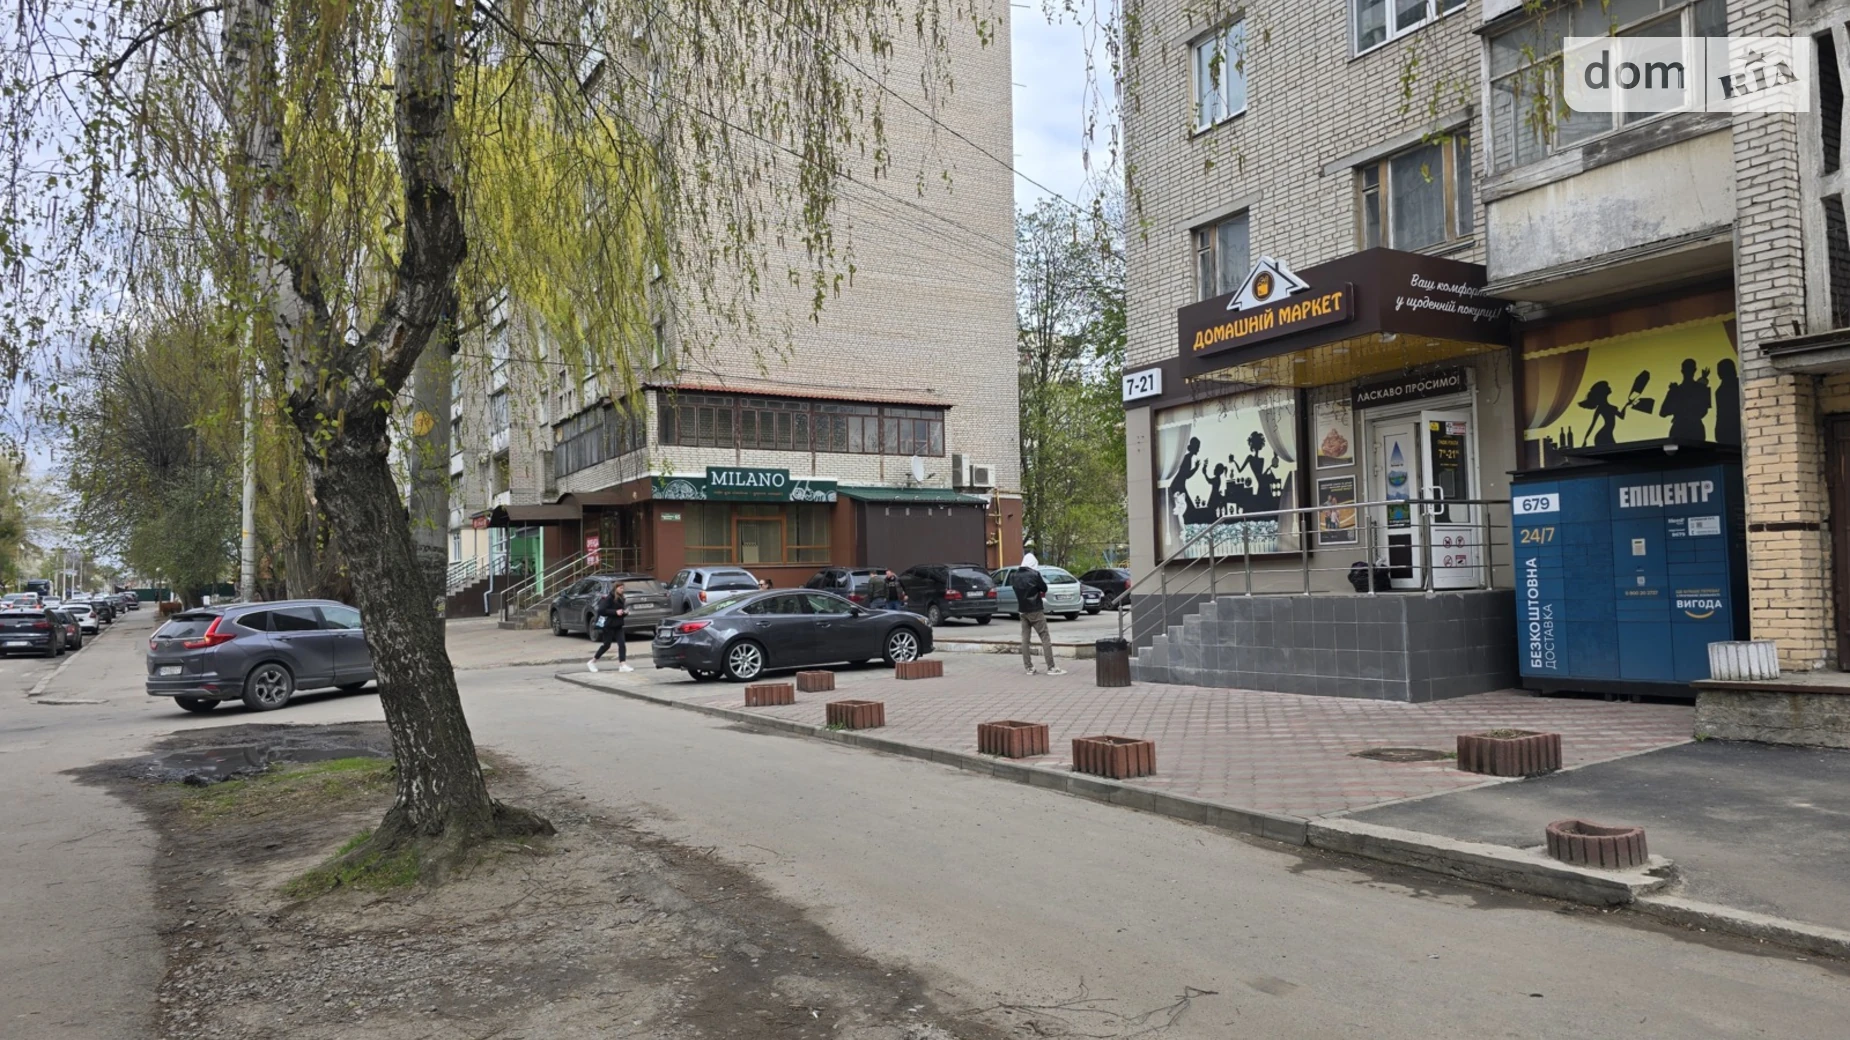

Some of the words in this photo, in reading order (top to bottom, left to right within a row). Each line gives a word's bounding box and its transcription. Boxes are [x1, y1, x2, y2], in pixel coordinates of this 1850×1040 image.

[1410, 273, 1436, 291] Ваш
[1395, 296, 1404, 311] у
[1193, 308, 1274, 351] ДОМАШНІЙ
[1278, 291, 1343, 326] МАРКЕТ
[1126, 374, 1154, 396] 7-21
[1357, 385, 1403, 403] ЛАСКАВО
[1405, 375, 1460, 394] ПРОСИМО!
[711, 471, 785, 487] MILANO
[1522, 497, 1550, 511] 679
[1620, 480, 1714, 508] ЕПІЦЕНТР
[1520, 527, 1555, 544] 24/7
[1526, 557, 1542, 668] БЕЗКОШТОВНА
[1676, 599, 1723, 609] ВИГОДА
[1543, 603, 1557, 670] ДОСТАВКА
